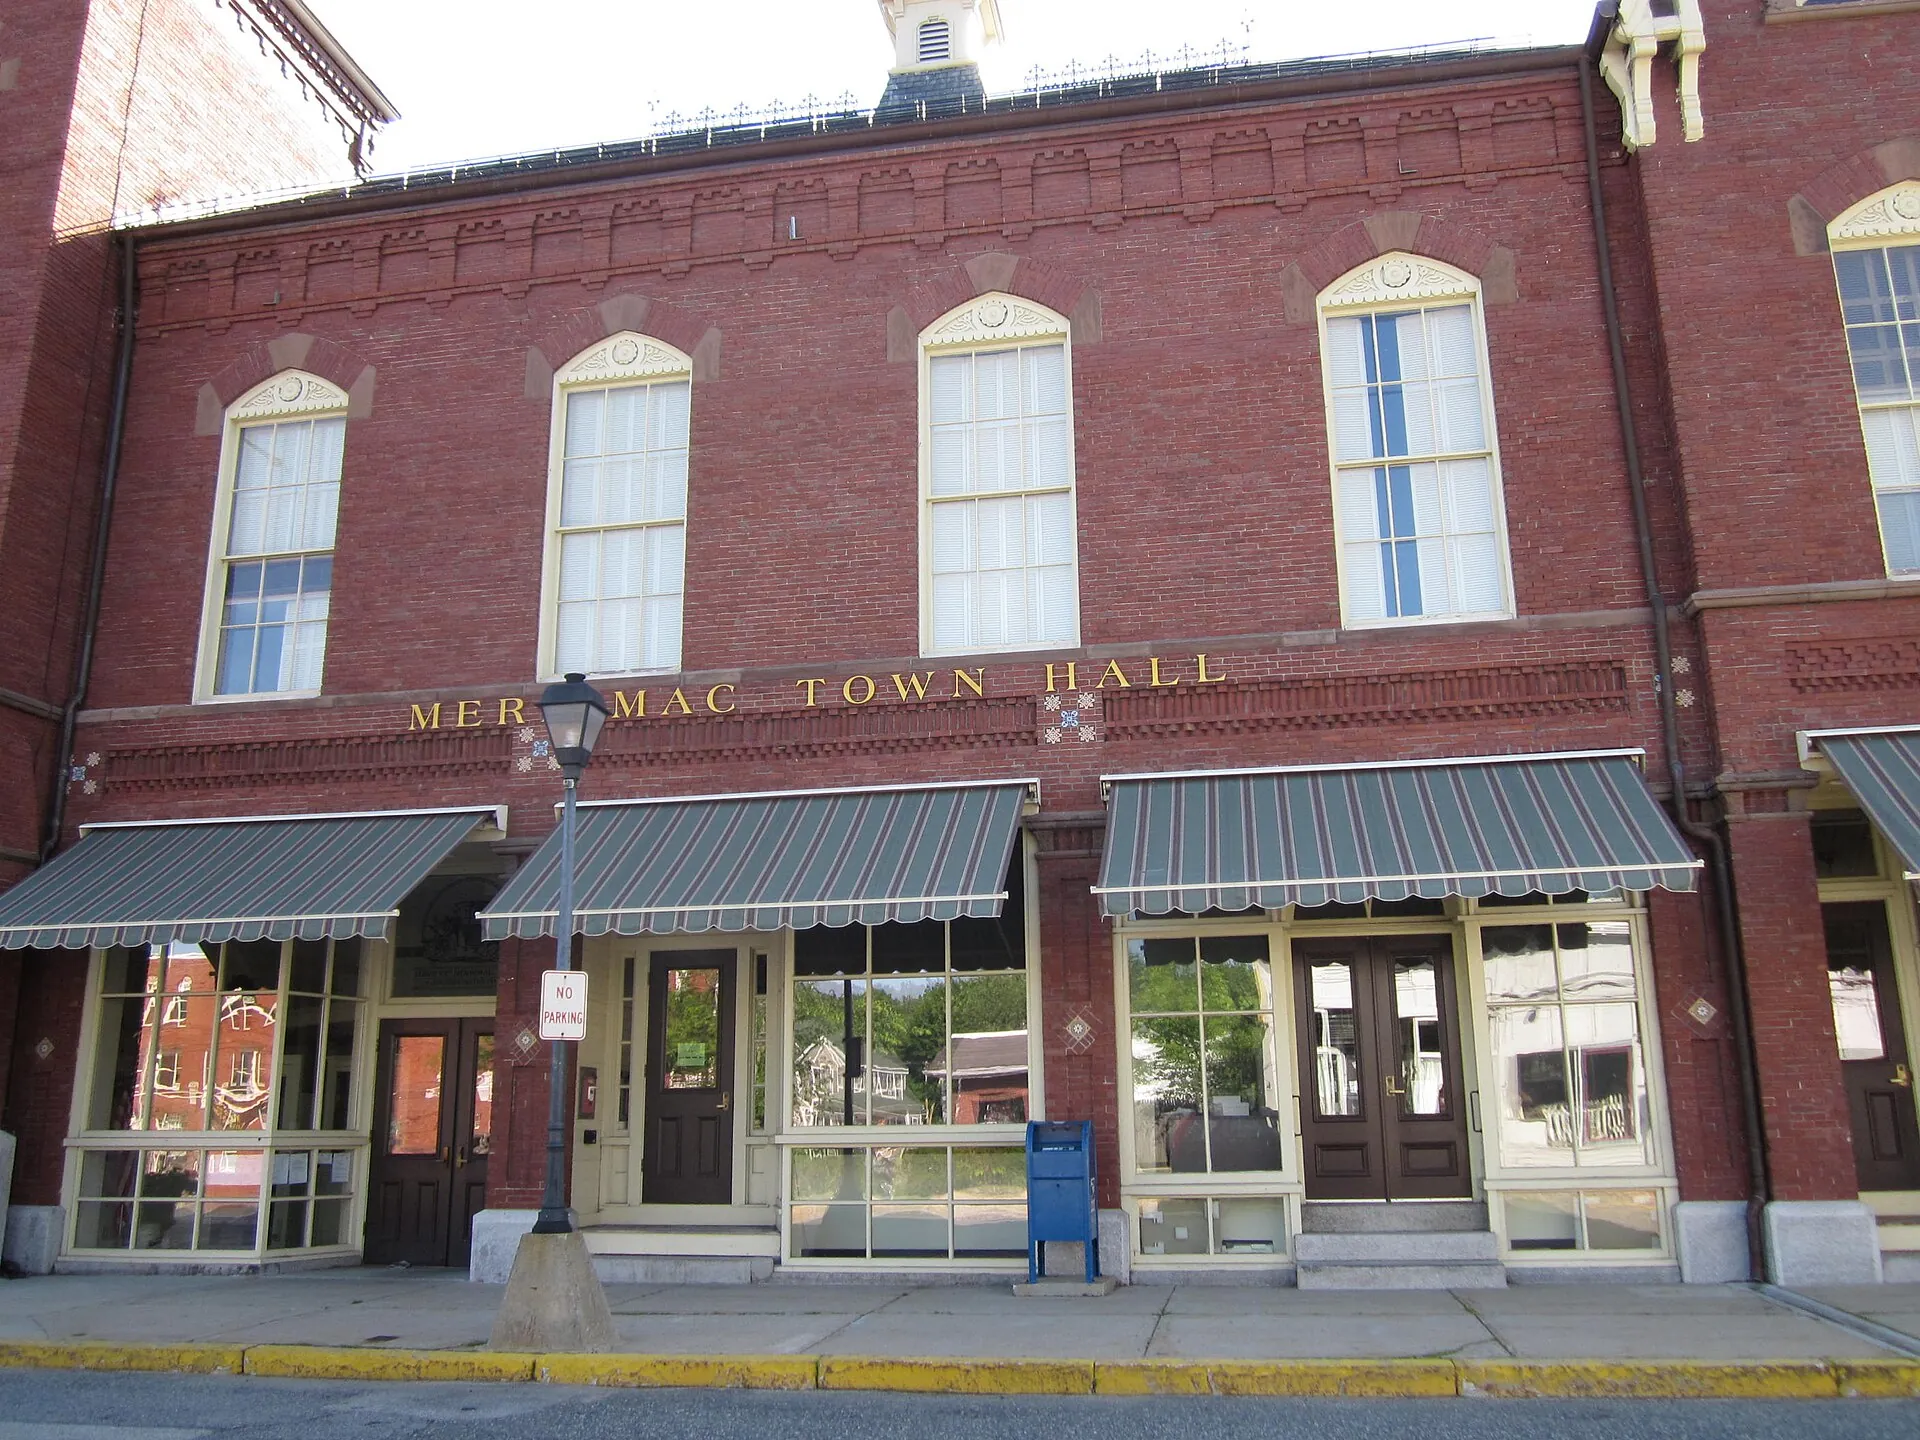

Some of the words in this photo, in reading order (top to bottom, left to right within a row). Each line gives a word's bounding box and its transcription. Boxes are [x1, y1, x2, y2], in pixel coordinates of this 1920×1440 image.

[408, 684, 736, 731] MERMAC
[795, 667, 986, 707] TOWN
[1044, 653, 1227, 692] HALL
[556, 987, 573, 999] NO
[544, 1011, 583, 1024] PARKING
